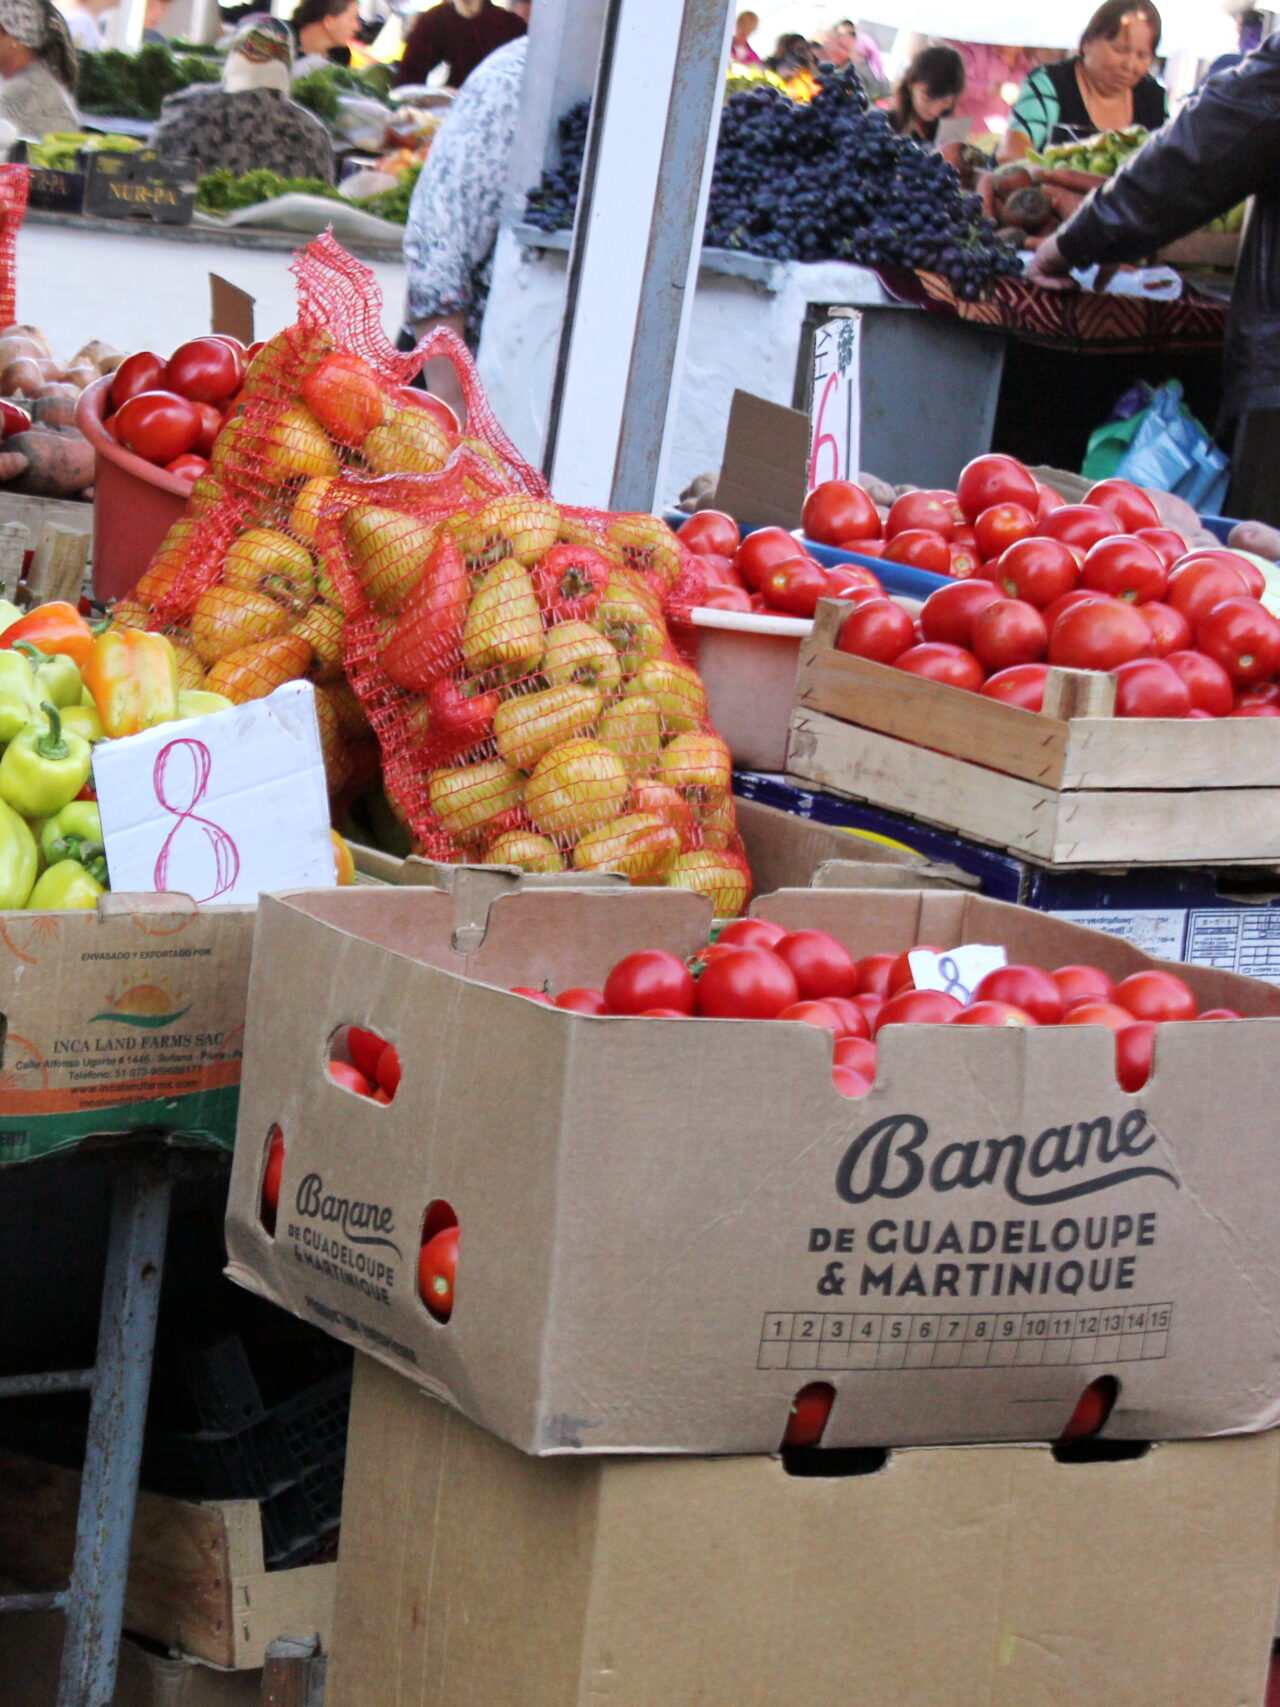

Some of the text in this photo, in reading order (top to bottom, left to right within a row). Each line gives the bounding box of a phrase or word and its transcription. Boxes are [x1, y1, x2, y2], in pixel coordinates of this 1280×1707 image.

[109, 182, 178, 206] NUR-PA
[153, 738, 240, 904] 8
[81, 952, 131, 961] ENVASADO
[139, 949, 192, 960] EXPORTADO
[938, 956, 971, 1006] 8
[53, 1032, 225, 1053] INCA LAND FARMS SAC
[835, 1108, 1180, 1206] Banane
[295, 1173, 404, 1262] Banane
[807, 1212, 1157, 1255] DE GUADELOUPE
[288, 1223, 394, 1287] DE GUADELOUPE
[816, 1255, 1137, 1298] & MARTINIQUE
[303, 1255, 390, 1306] MARTINIQUE
[773, 1310, 1169, 1338] 1 2 3 4 5 6 7 8 9 10 11 12 13 14 15
